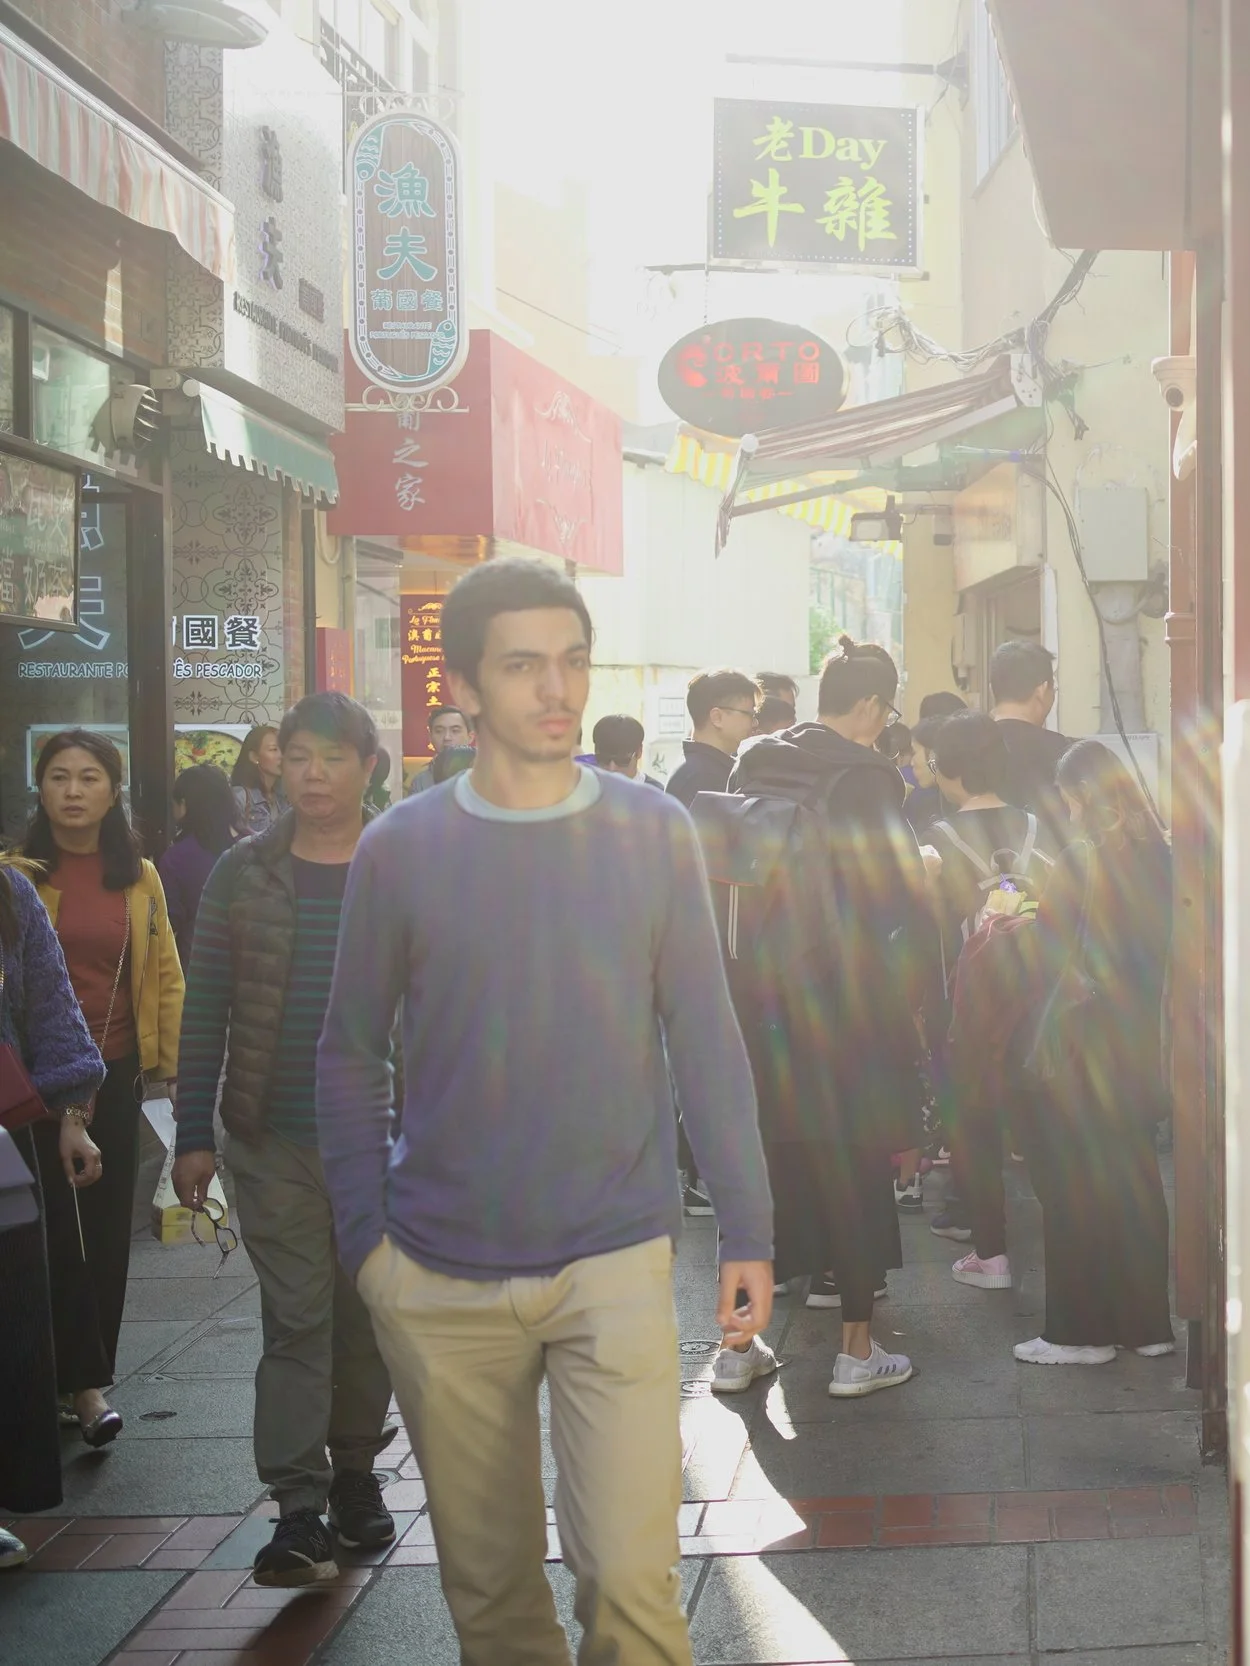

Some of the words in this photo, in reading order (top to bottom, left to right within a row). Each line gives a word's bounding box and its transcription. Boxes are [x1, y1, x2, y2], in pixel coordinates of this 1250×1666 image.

[373, 161, 438, 282] 漁夫
[733, 167, 898, 252] 牛雜
[370, 288, 444, 312] 葡國餐
[172, 614, 262, 650] 國餐
[17, 661, 114, 680] RESTAURANTE
[195, 662, 263, 680] PESCADOR
